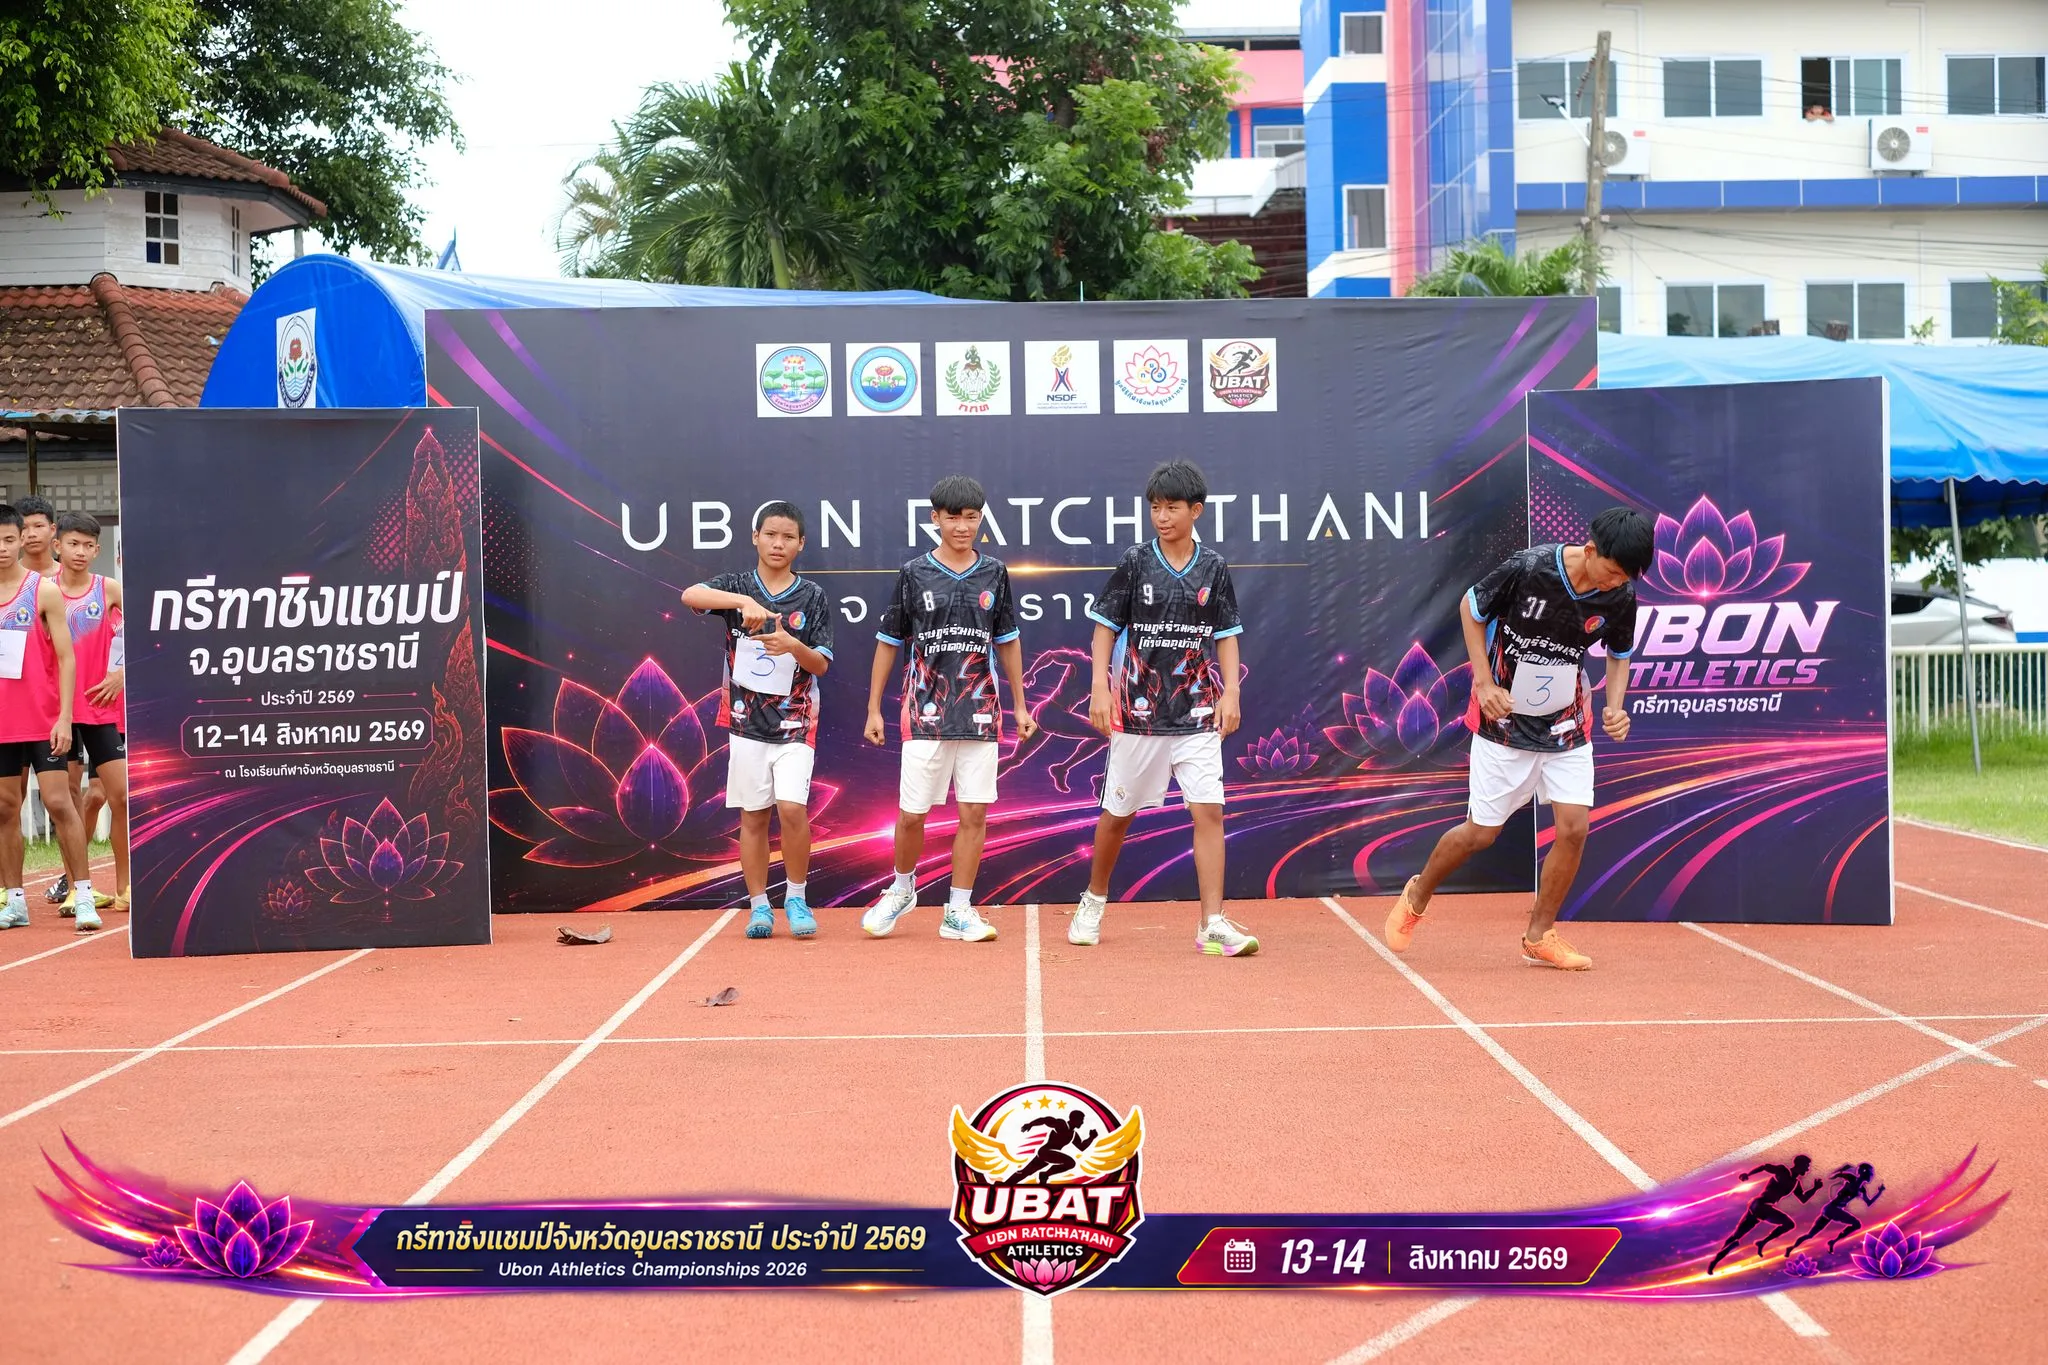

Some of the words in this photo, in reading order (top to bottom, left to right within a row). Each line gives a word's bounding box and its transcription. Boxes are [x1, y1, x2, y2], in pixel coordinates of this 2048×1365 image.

[1215, 376, 1266, 391] UBAT
[621, 499, 862, 551] UBN
[908, 491, 1428, 547] RATCHTHANI
[150, 571, 464, 631] กรีฑาชิงแชมป์
[922, 590, 935, 612] 8
[1142, 583, 1154, 605] 9
[1521, 596, 1547, 620] 31
[189, 631, 420, 686] จ.อุบลราชธานี
[1592, 658, 1834, 691] THLETICS
[261, 689, 313, 706] ประจำปี
[317, 689, 356, 704] 2569
[1526, 675, 1554, 707] 3
[1632, 692, 1782, 719] กรีฑาอุบลราชธานี
[276, 722, 361, 746] สิงหาคม
[368, 719, 426, 742] 2569
[224, 769, 236, 778] ณ
[239, 759, 395, 778] โรงเรียนกีฬาจังหวัดอุบลราชธานี
